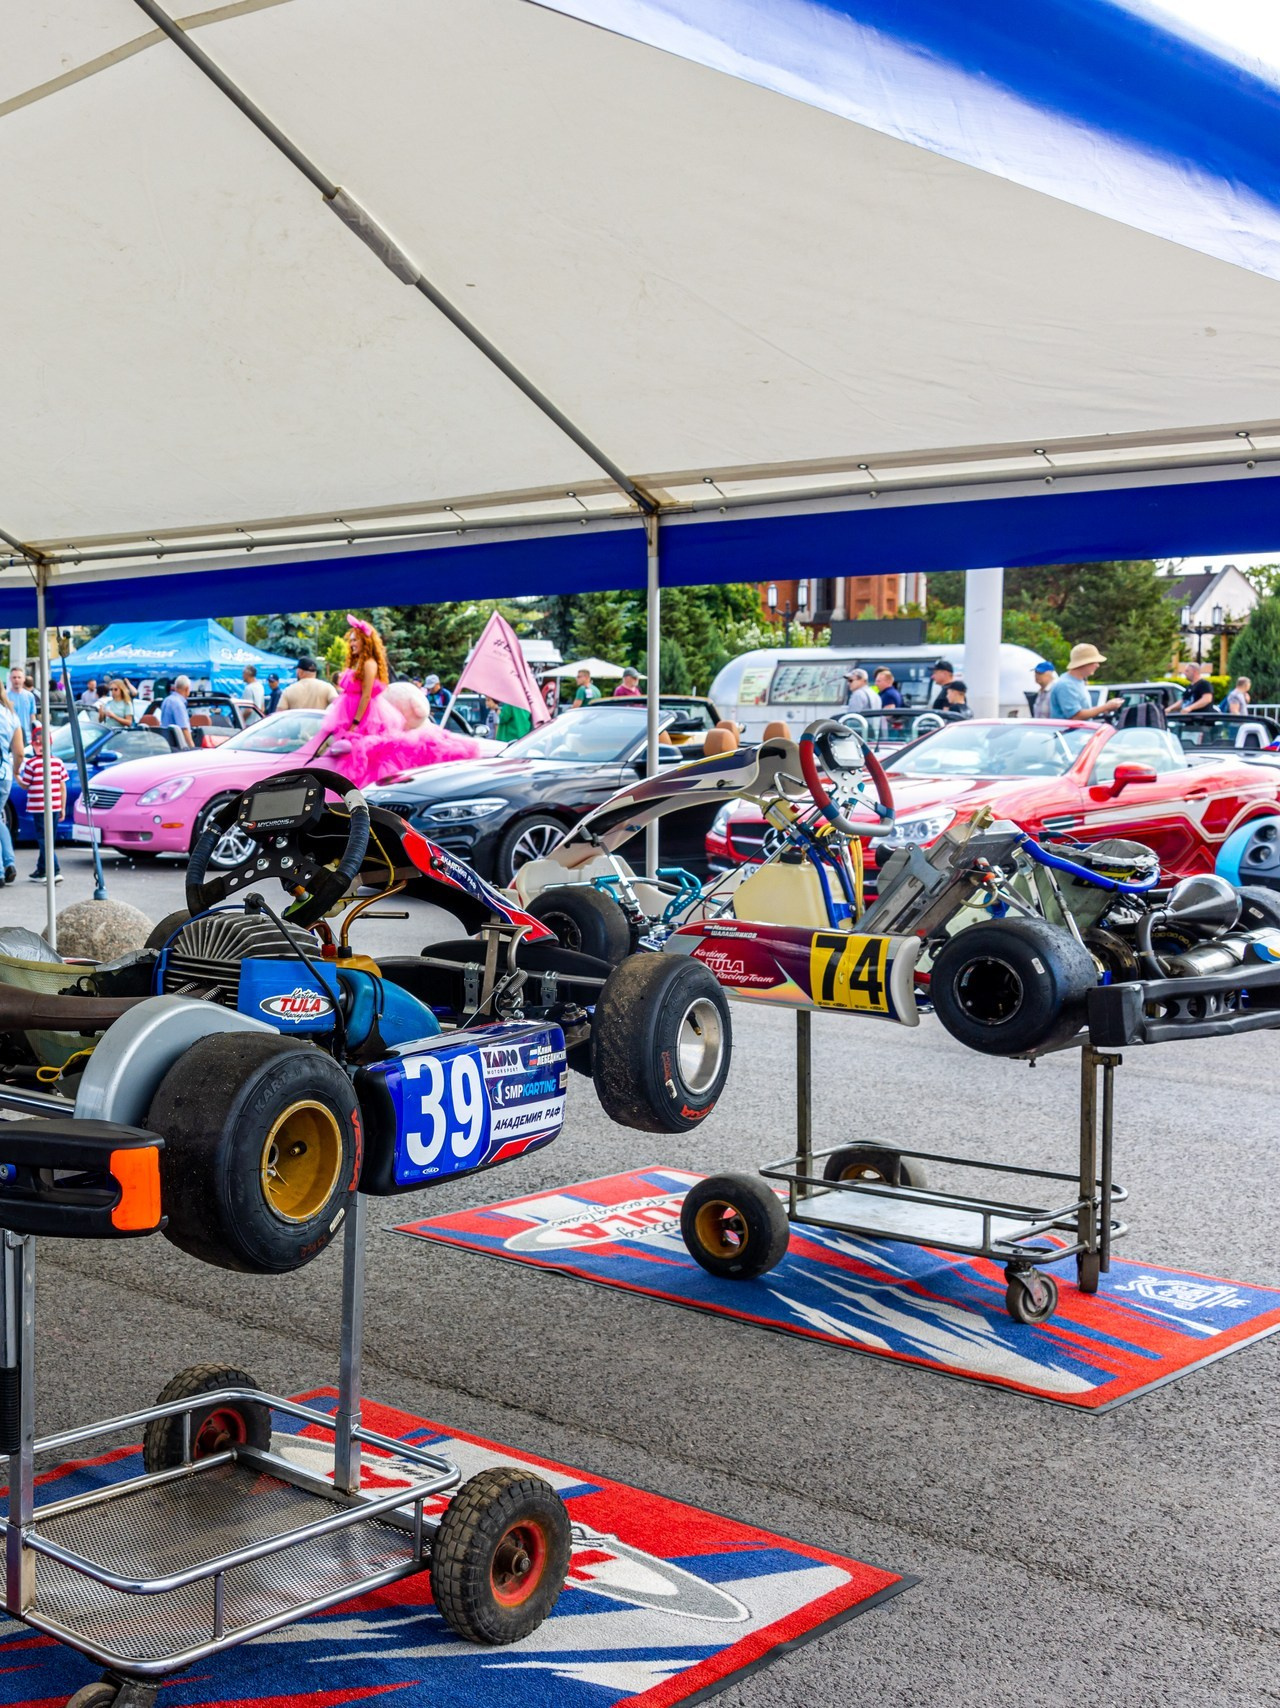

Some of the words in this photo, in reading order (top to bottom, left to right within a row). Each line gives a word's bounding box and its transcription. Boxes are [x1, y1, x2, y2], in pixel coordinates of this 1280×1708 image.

[440, 855, 468, 879] АКАДЕМИЯ
[467, 876, 477, 889] РАФ
[694, 948, 728, 961] Karting
[706, 957, 744, 974] TULA
[815, 934, 884, 1005] 74
[717, 972, 749, 984] Racing
[748, 973, 774, 983] Team
[280, 998, 322, 1012] TULA
[487, 1067, 518, 1075] MOTORSPORT
[402, 1054, 483, 1166] 39
[494, 1110, 543, 1131] АКАДЕМИЯ
[545, 1106, 560, 1119] РАФ
[349, 1108, 362, 1191] VEGA
